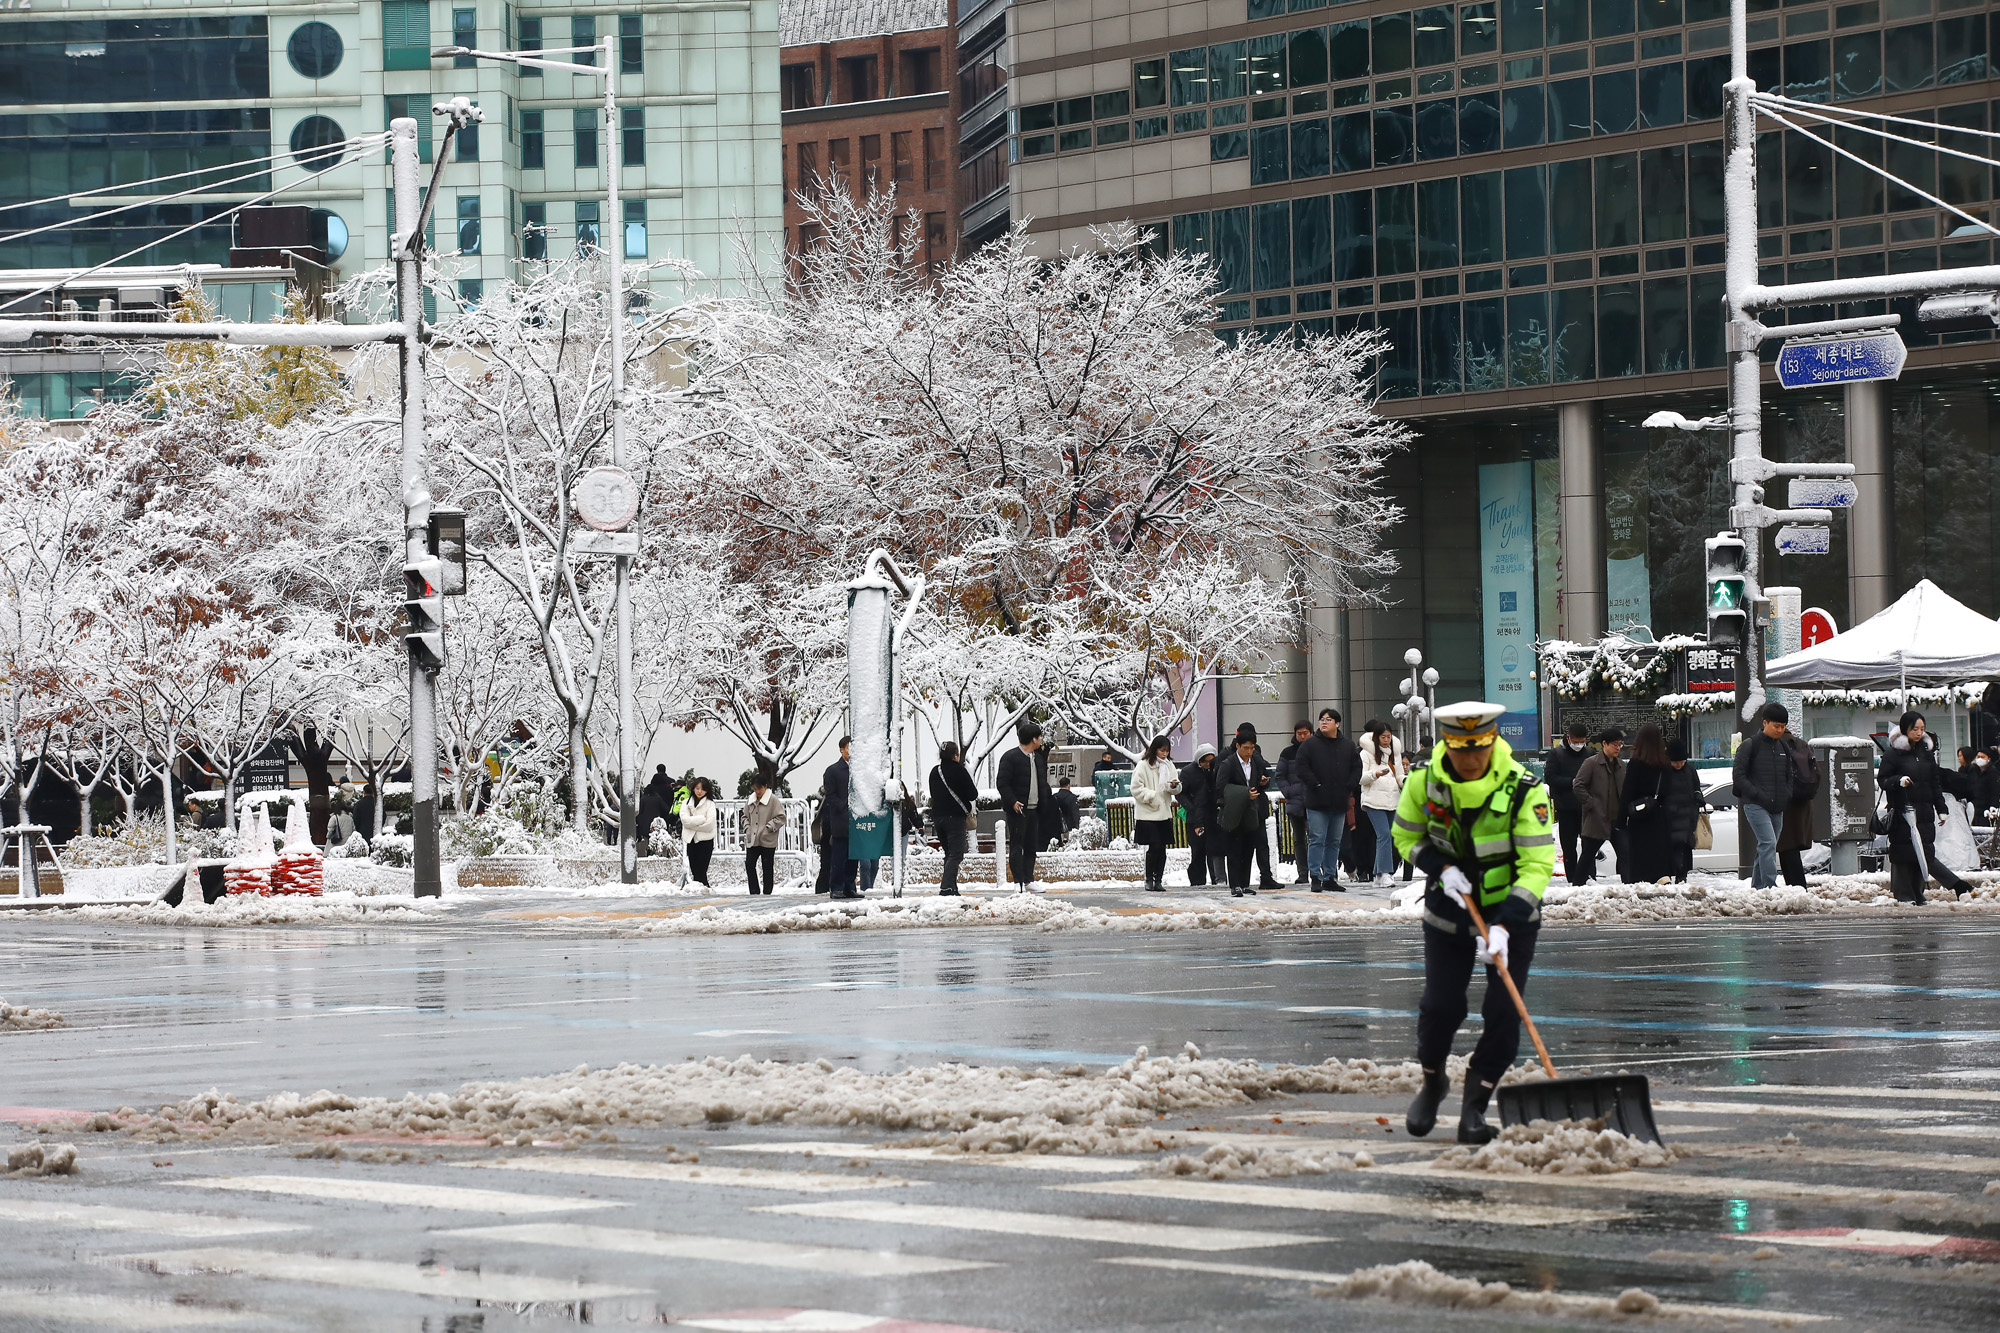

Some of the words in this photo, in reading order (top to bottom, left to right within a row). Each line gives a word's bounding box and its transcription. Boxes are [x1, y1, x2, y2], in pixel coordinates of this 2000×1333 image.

[1816, 344, 1864, 365] 세종대로
[1783, 359, 1800, 374] 153
[1811, 366, 1868, 382] Sejong-daero
[1482, 491, 1521, 530] Thank
[1609, 515, 1633, 528] 법무법인
[1613, 528, 1631, 540] 광화문
[1687, 649, 1718, 670] 광화문
[1500, 726, 1523, 736] 롯데관광
